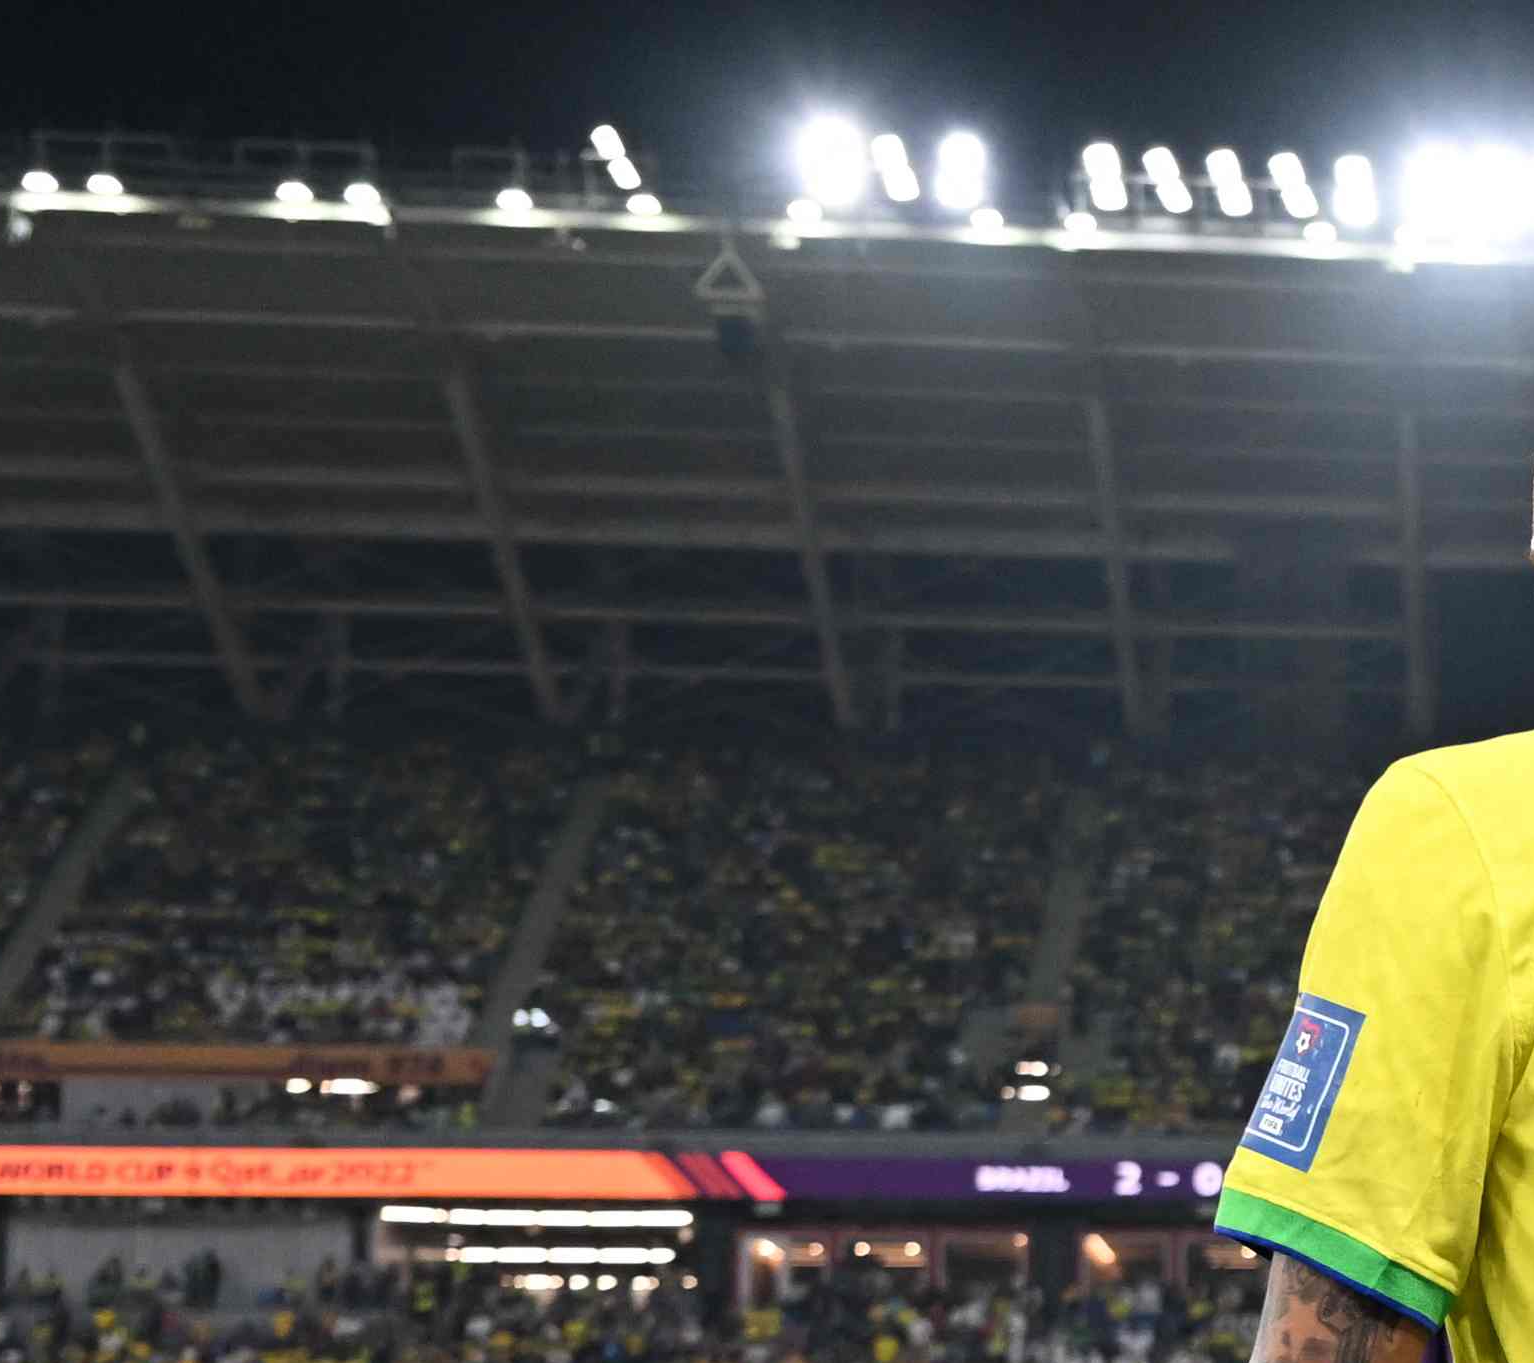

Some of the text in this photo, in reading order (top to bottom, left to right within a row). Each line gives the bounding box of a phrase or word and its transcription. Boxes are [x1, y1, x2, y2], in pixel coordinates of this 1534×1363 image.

[114, 1161, 174, 1183] CUP
[1114, 1160, 1143, 1196] 2
[1192, 1161, 1224, 1197] 0
